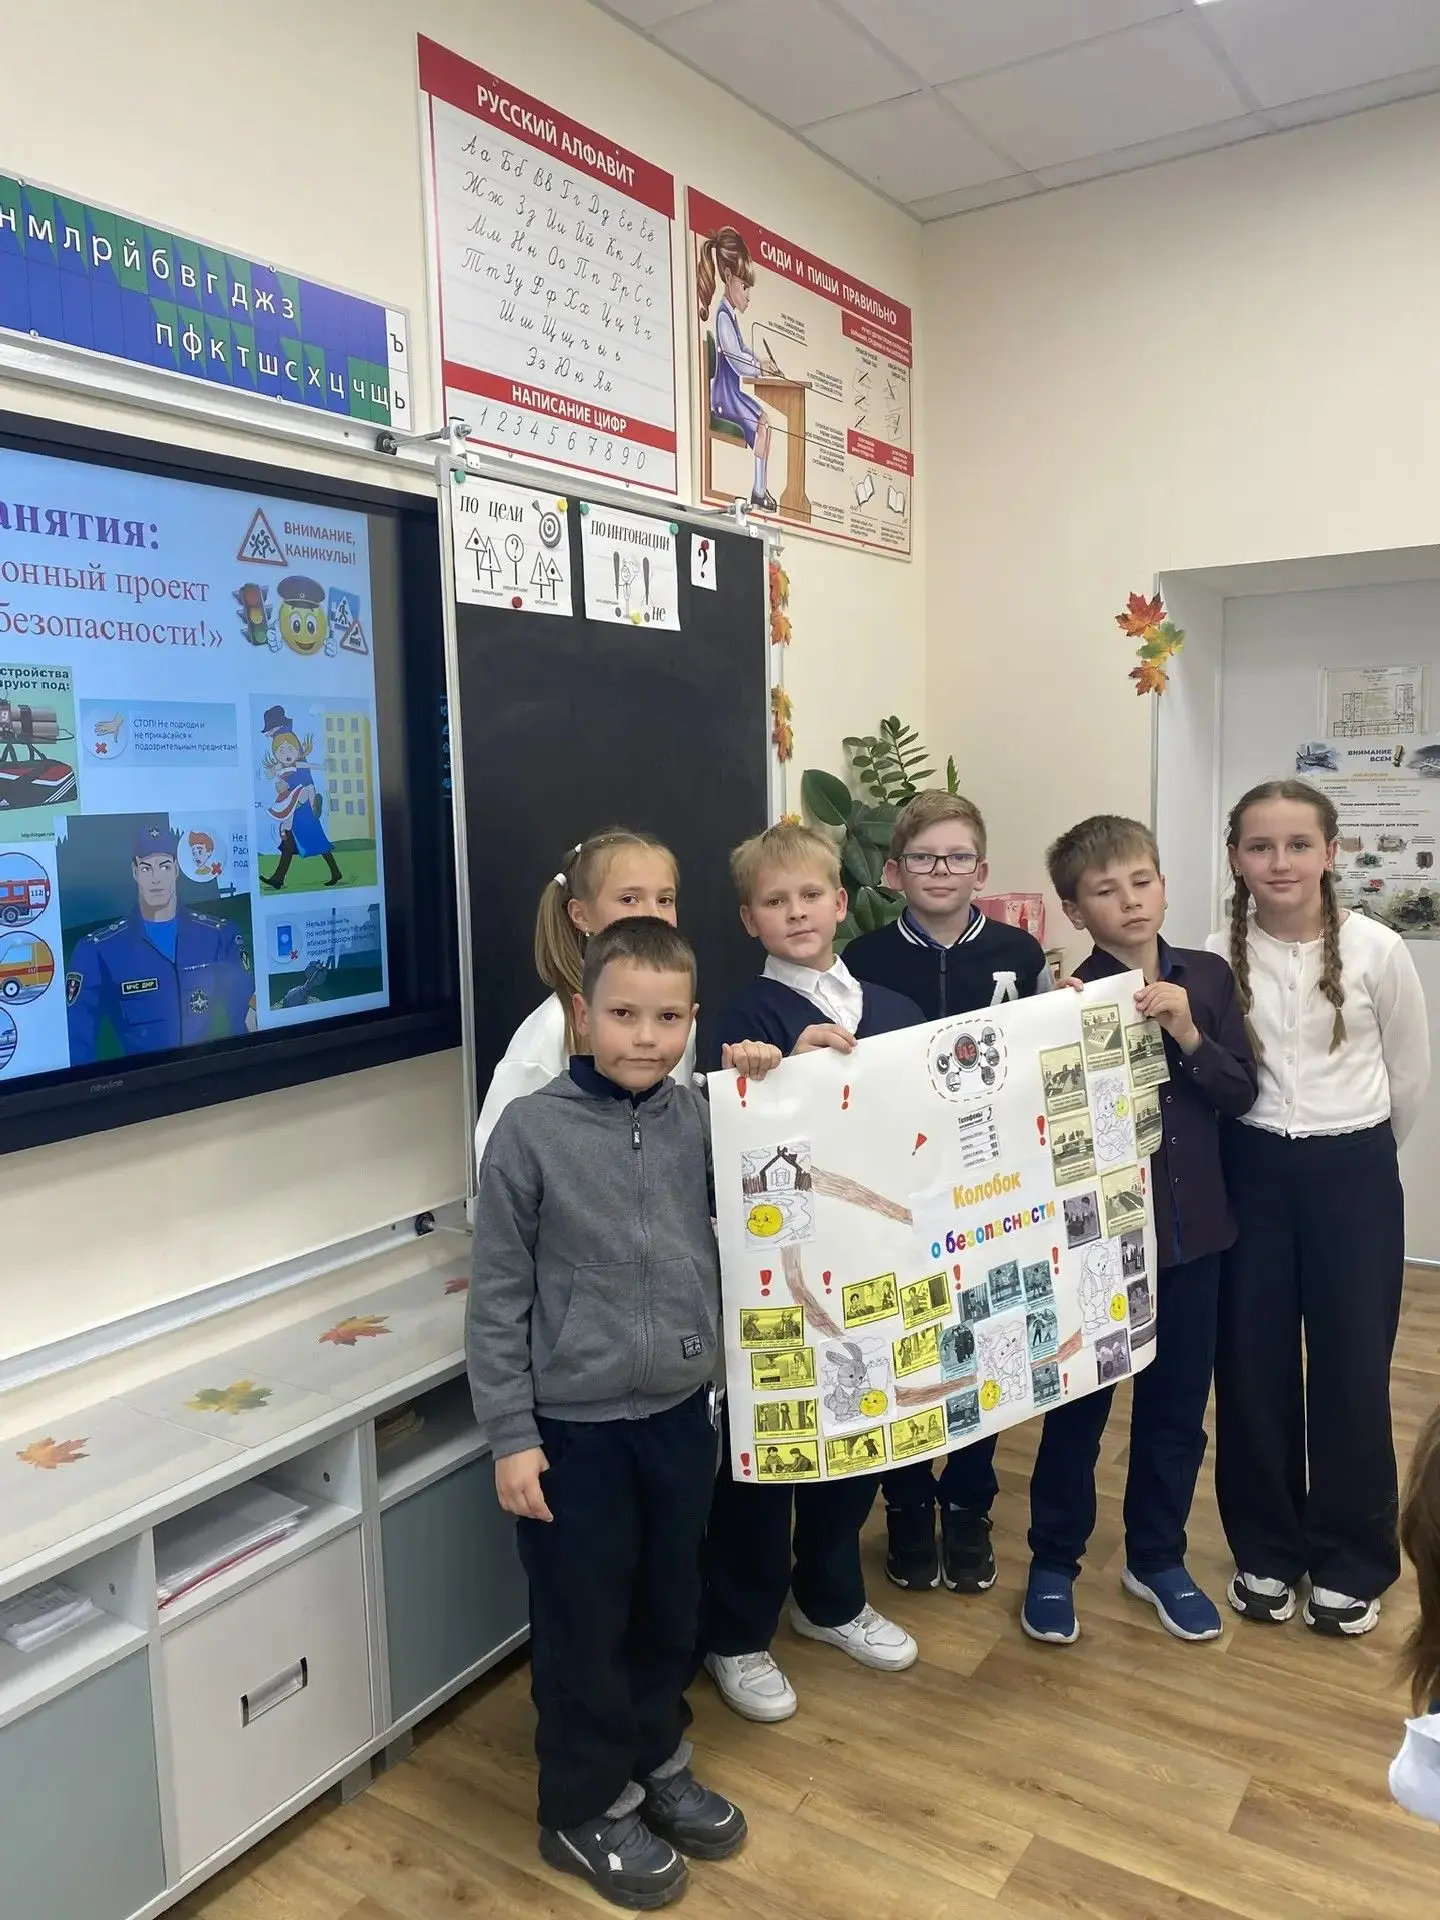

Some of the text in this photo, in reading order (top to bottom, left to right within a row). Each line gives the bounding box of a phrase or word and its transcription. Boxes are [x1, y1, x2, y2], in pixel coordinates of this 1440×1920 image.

[477, 84, 635, 187] РУССКИЙ АЛФАВИТ
[760, 241, 897, 326] СИДИ И ПИШИ ПРАВИЛЬНО
[512, 385, 627, 433] НАПИСАНИЕ ЦИФР
[480, 406, 646, 470] 1 2 3 4 5 6 7 8 9 0
[284, 521, 356, 547] ВНИМАНИЕ,
[285, 543, 356, 565] КАНИКУЛЫ!
[1, 561, 210, 603] онный проект
[0, 667, 69, 679] стройства
[41, 681, 70, 691] под:
[133, 719, 157, 728] СТОП!
[158, 720, 169, 728] Не
[169, 721, 199, 729] подходи
[1347, 749, 1392, 757] ВНИМАНИЕ
[232, 833, 243, 842] Не
[952, 1171, 1022, 1210] Колобок
[931, 1200, 1056, 1259] о безопасности
